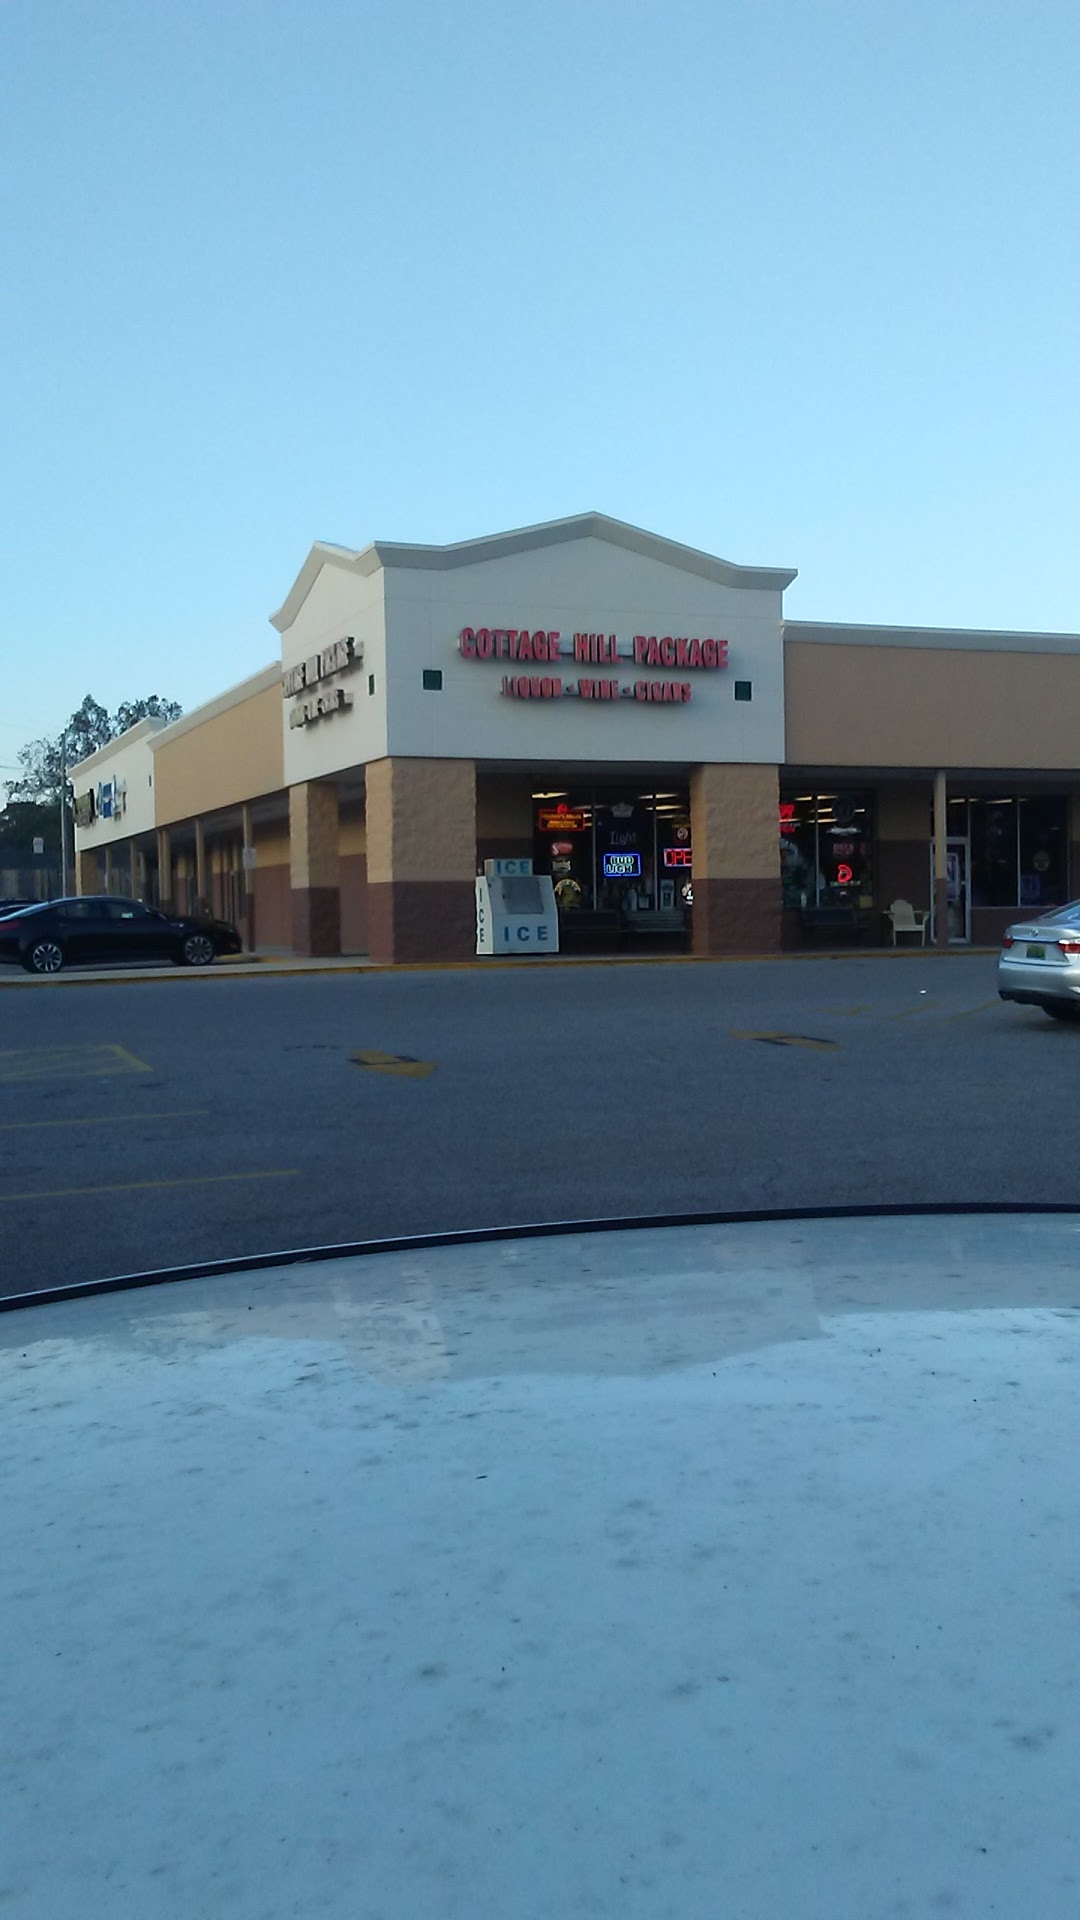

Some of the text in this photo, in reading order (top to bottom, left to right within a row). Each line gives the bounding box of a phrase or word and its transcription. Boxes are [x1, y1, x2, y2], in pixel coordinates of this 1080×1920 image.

[459, 628, 729, 668] COTTAGE HILL PACKAGE
[502, 676, 691, 702] LIQUOR WINE CIGARS
[610, 855, 635, 865] BUD
[665, 850, 692, 866] OPE
[496, 860, 530, 875] ICE
[504, 926, 548, 941] ICE
